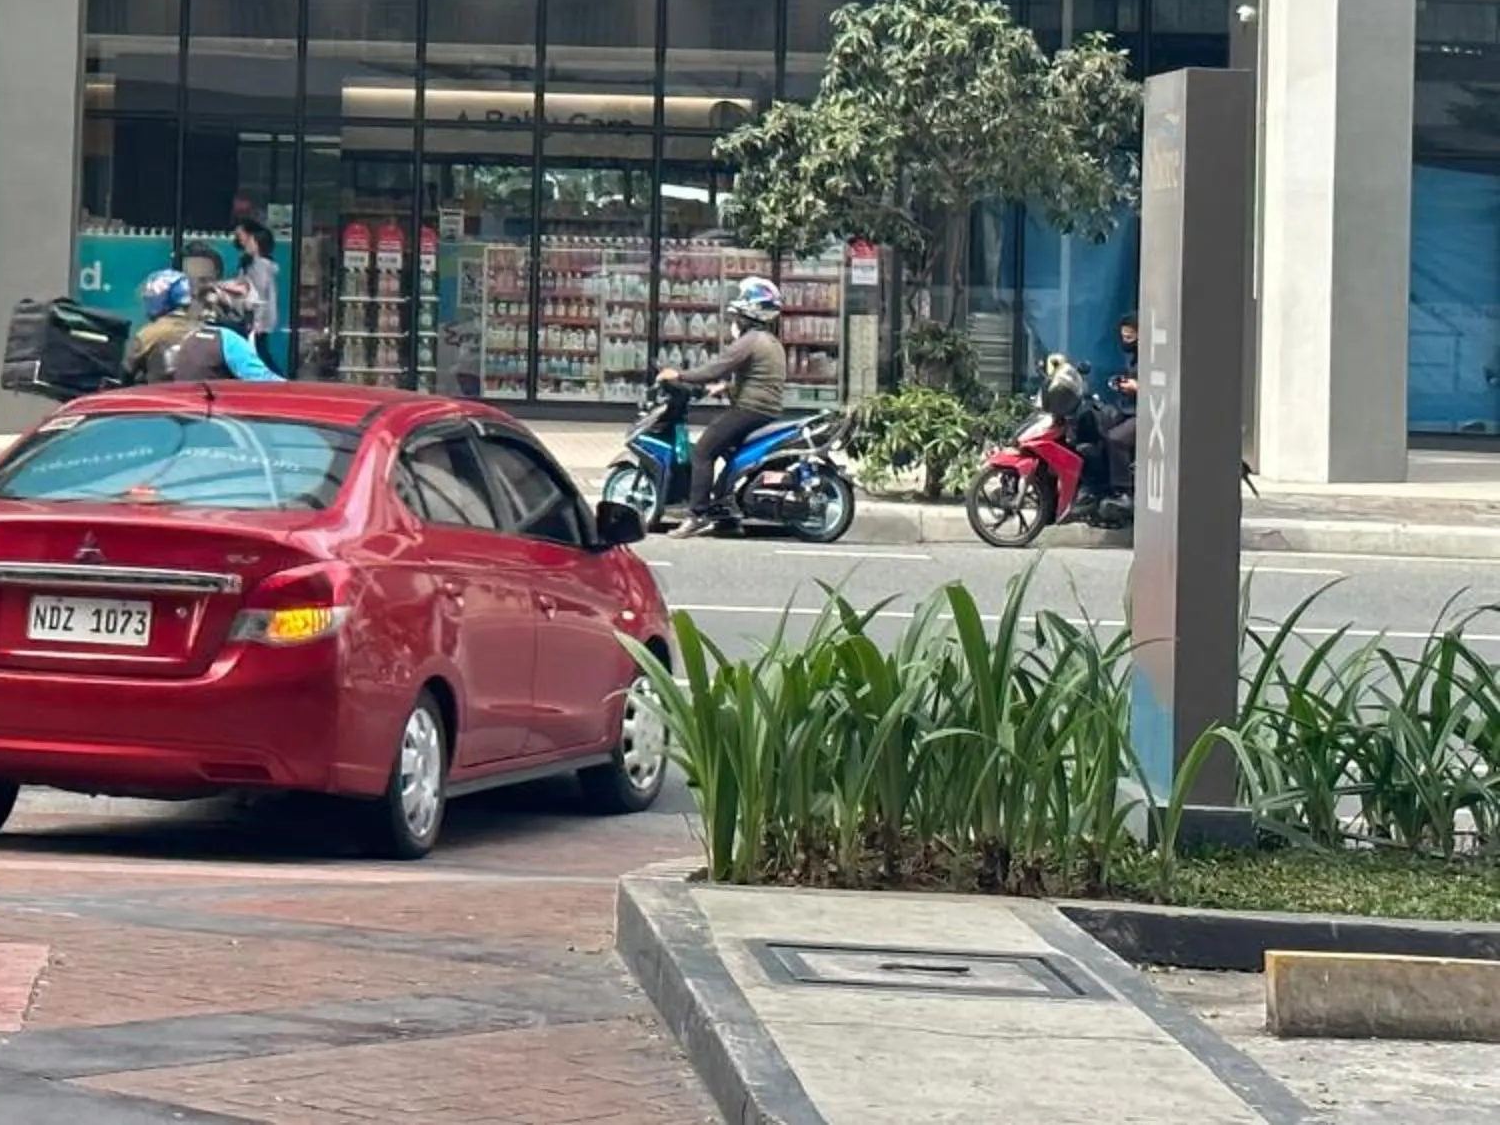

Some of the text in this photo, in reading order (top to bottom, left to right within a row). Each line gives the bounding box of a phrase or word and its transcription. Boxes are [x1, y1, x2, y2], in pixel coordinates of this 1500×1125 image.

[1147, 309, 1168, 513] EXIT
[32, 605, 148, 636] NDZ 1073
